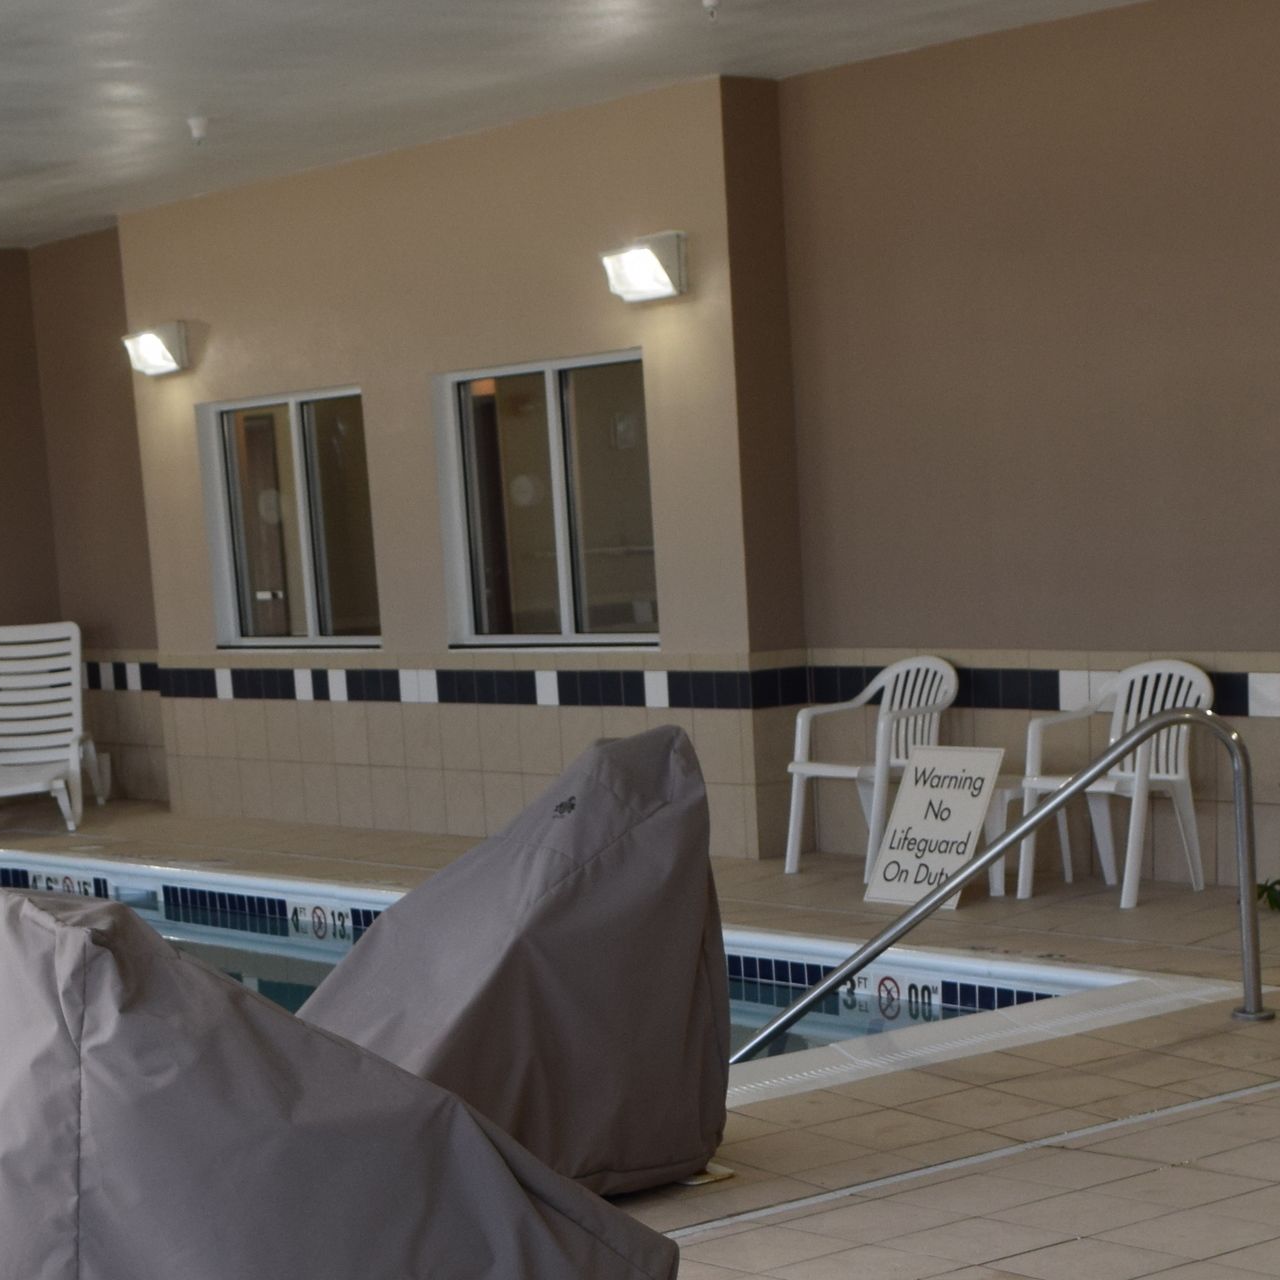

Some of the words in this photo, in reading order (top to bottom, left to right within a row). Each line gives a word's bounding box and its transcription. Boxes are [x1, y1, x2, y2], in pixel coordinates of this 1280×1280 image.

[914, 766, 986, 798] Warning
[924, 800, 952, 822] No
[889, 826, 972, 859] Lifeguard
[883, 860, 909, 883] On
